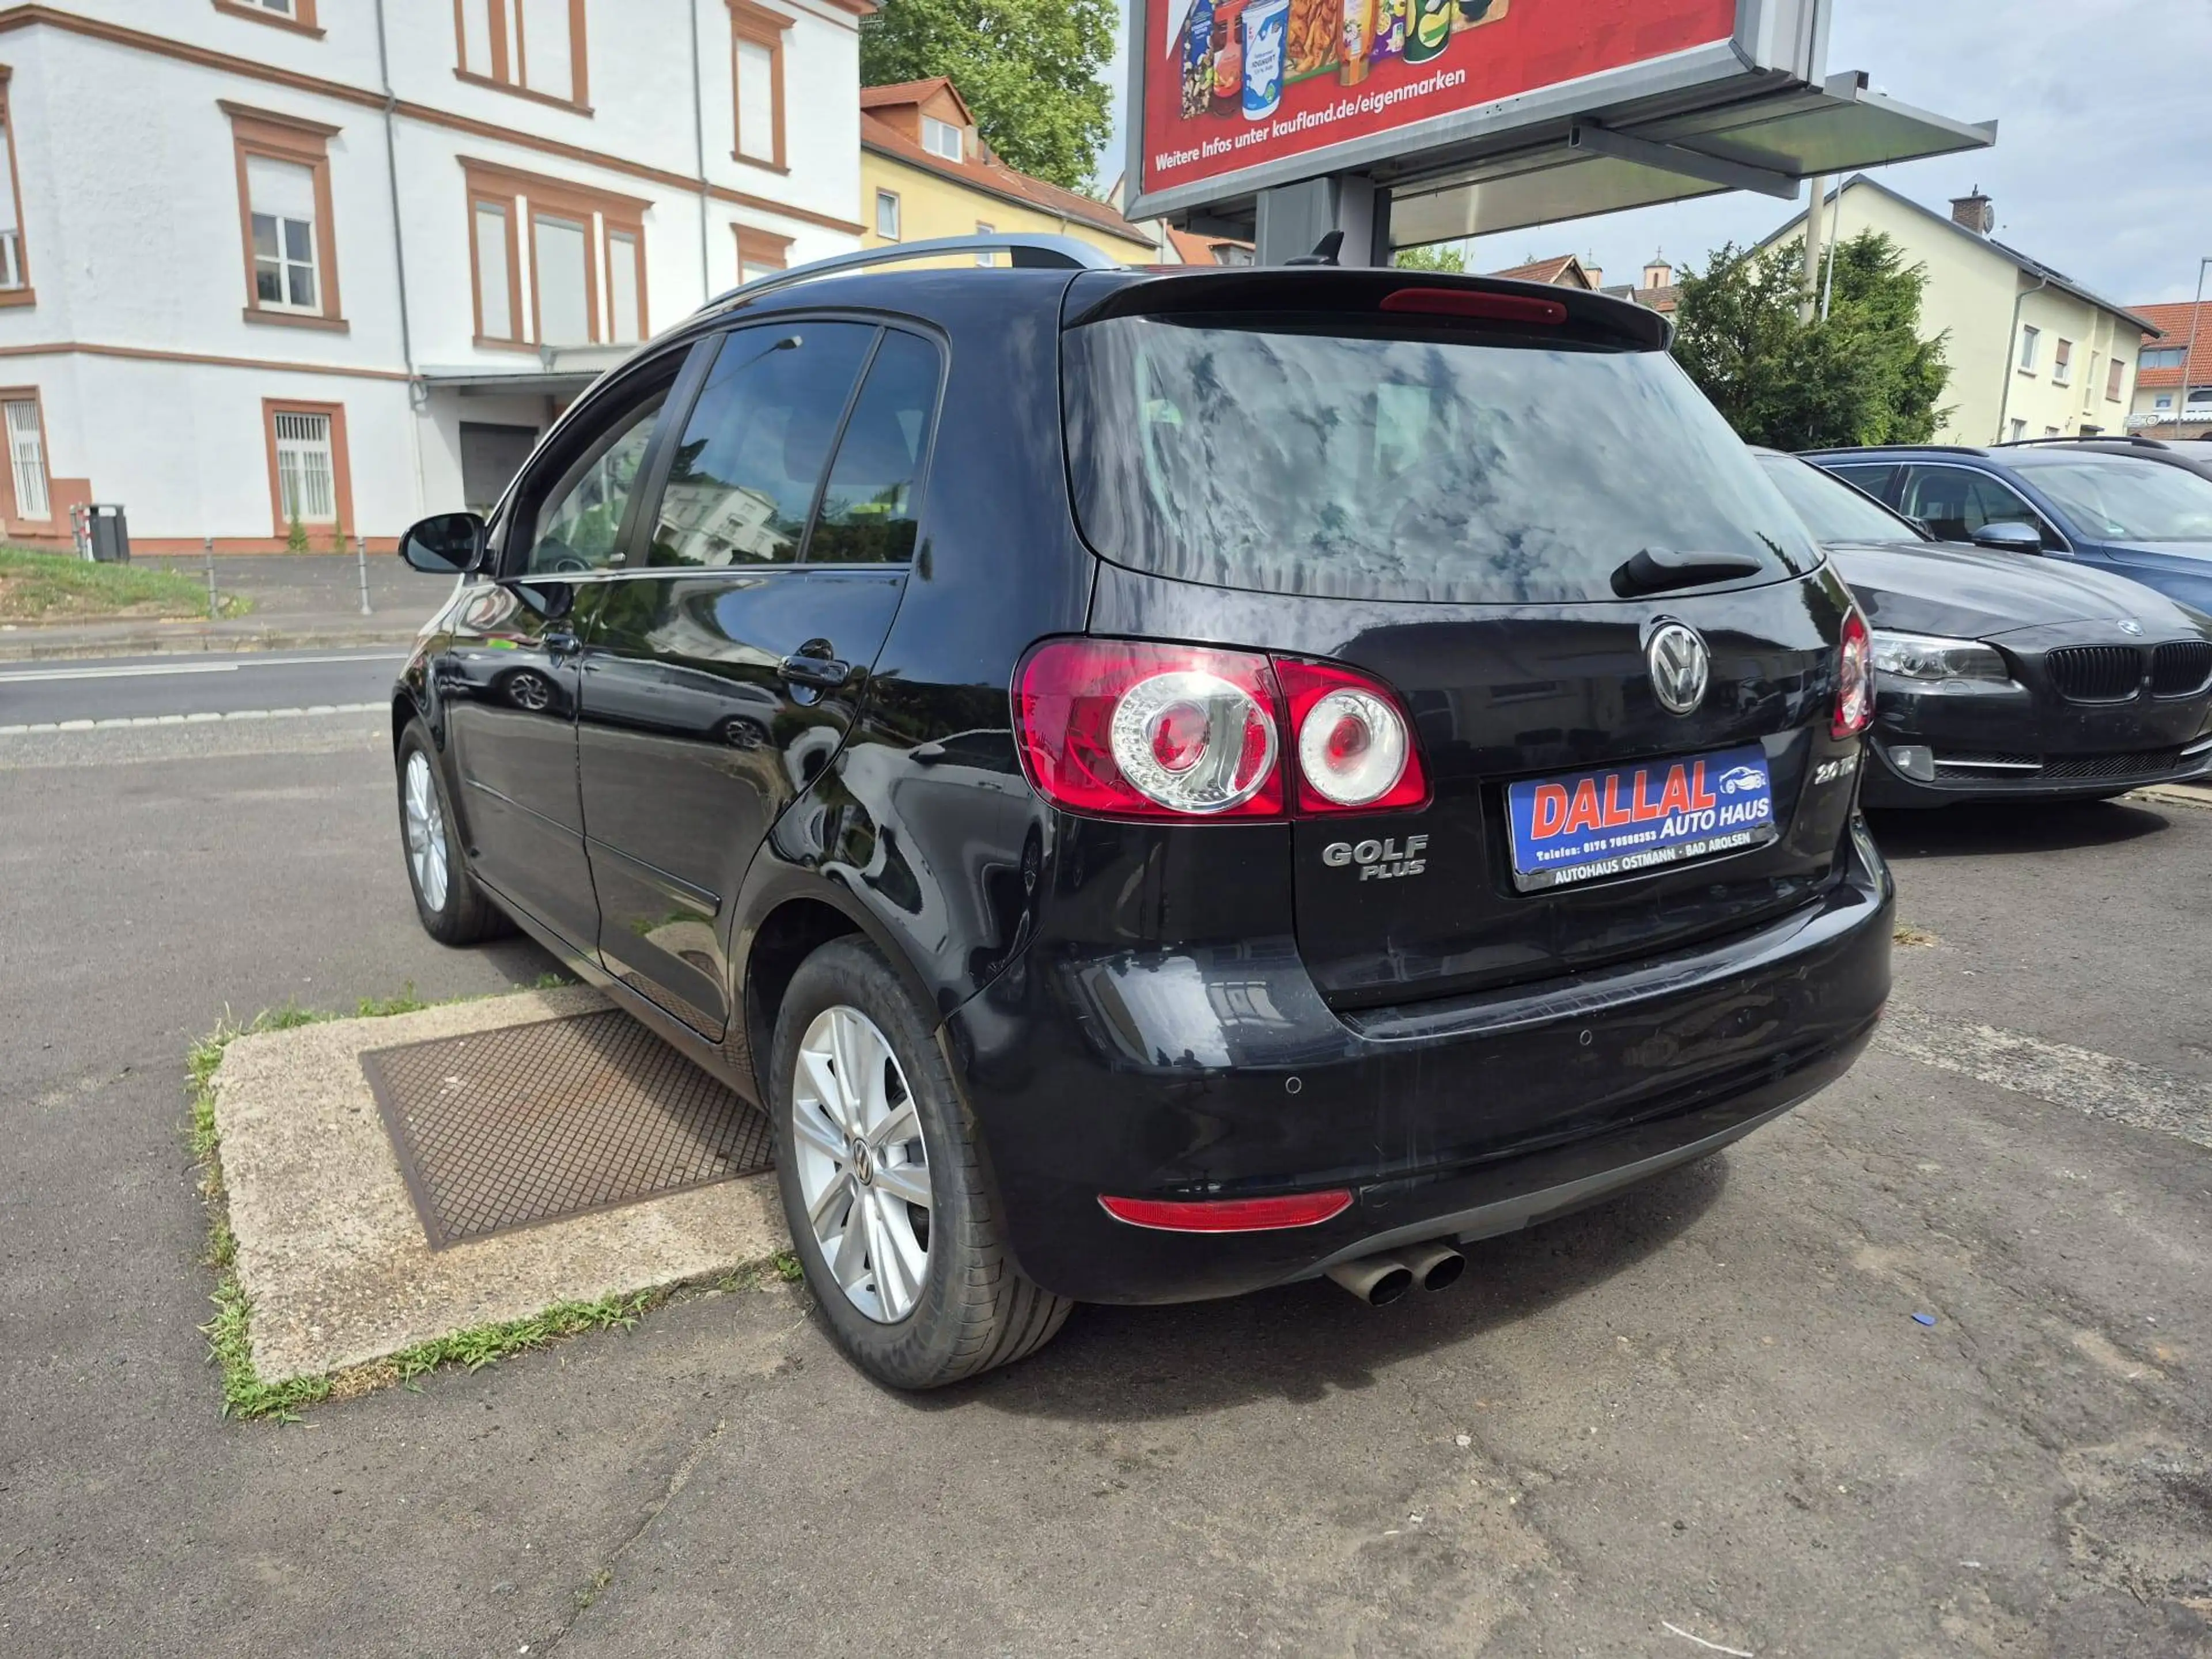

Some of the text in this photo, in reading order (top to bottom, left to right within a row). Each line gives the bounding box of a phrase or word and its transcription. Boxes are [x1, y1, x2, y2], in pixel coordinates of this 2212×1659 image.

[1156, 150, 1199, 171] Weitere
[1202, 137, 1232, 158] Infos
[1235, 126, 1269, 147] unter
[1272, 69, 1466, 138] kaufland.de/eigenmarken
[1531, 760, 1716, 840] DALLAL
[1660, 797, 1770, 839] AUTO HAUS
[1322, 834, 1429, 867] GOLF
[1359, 859, 1427, 881] PLUS
[1555, 832, 1751, 885] AUTOHAUS OSTMANN BAD AROLSEN
